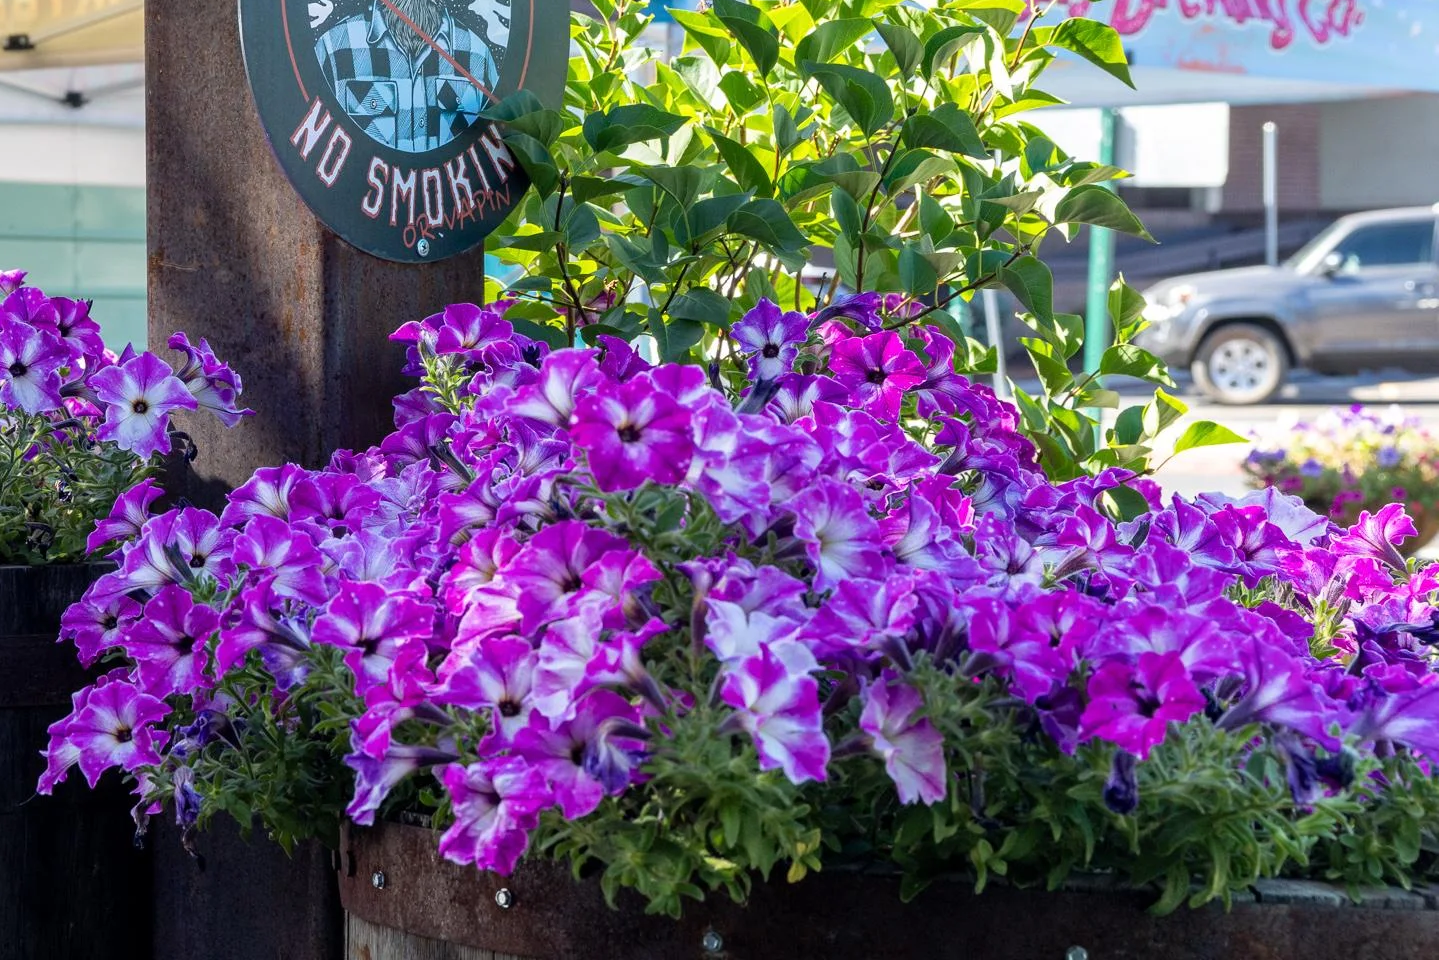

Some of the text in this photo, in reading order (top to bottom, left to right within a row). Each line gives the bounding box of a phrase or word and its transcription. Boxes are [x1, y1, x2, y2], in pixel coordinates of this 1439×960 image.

[289, 96, 515, 228] NO SMOKIN
[403, 183, 511, 248] OR VAPIN
